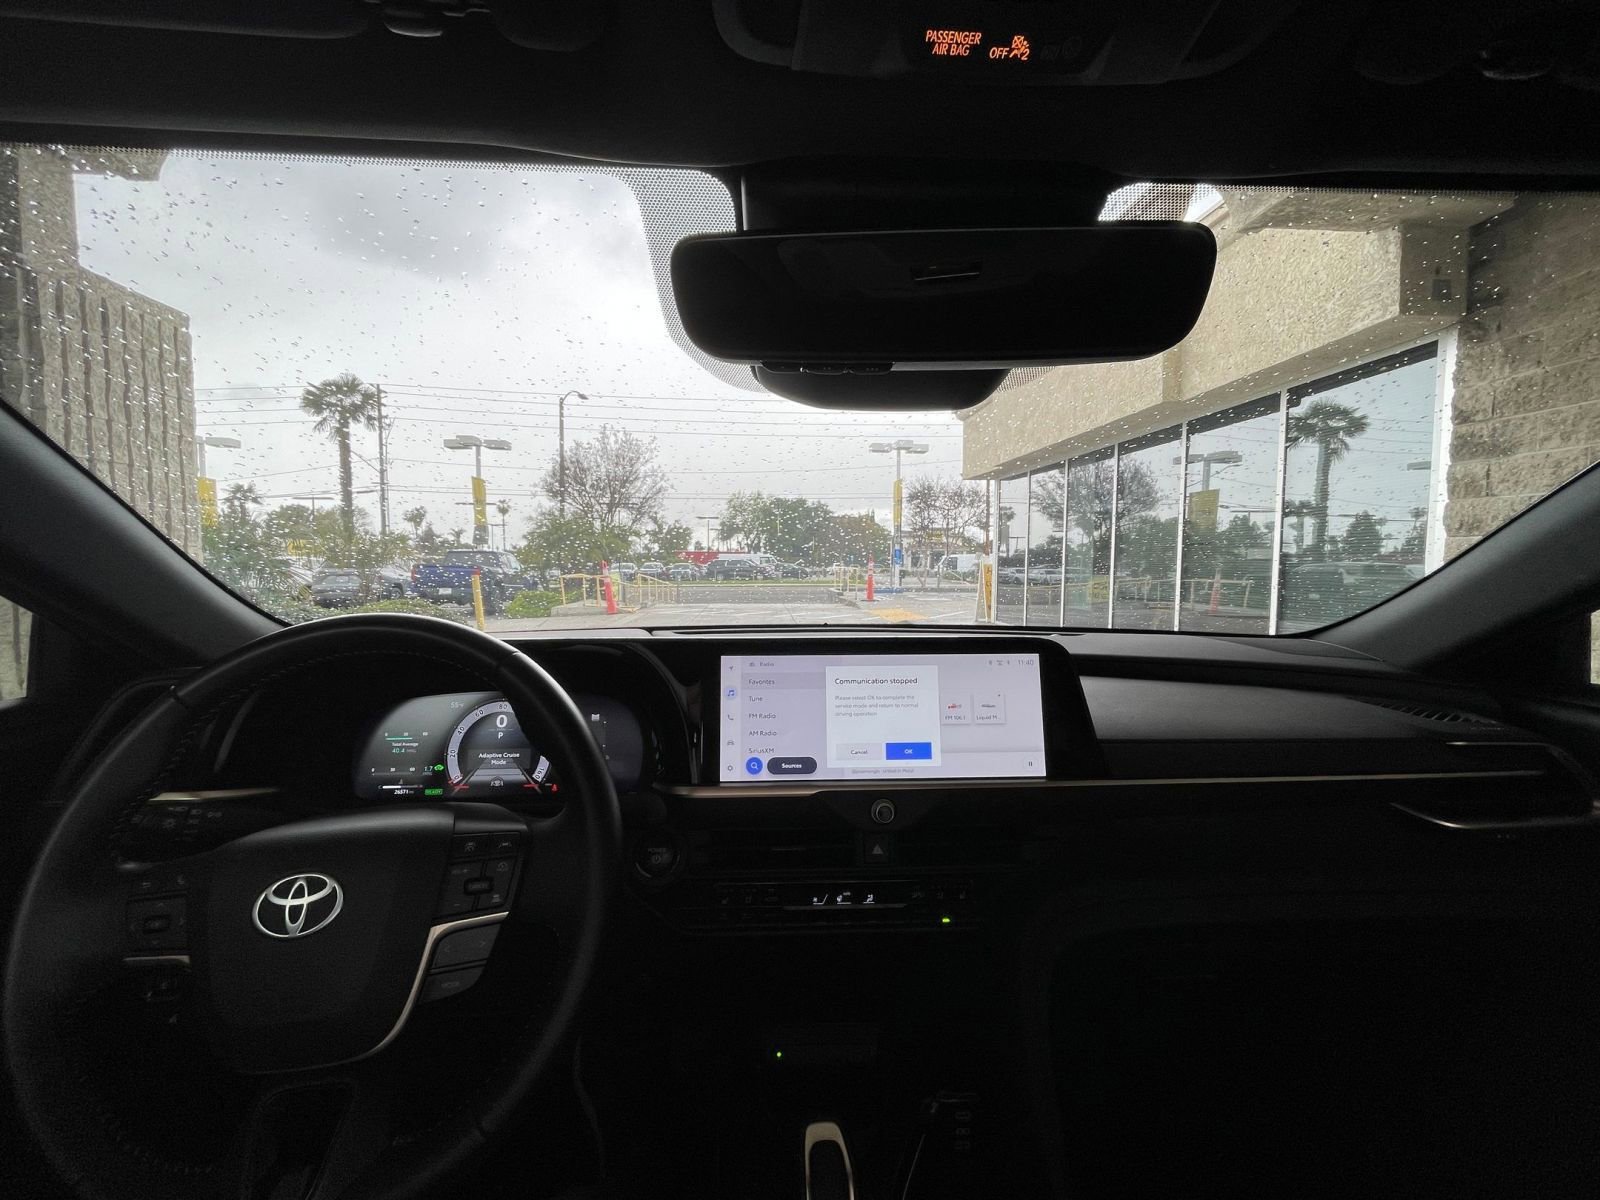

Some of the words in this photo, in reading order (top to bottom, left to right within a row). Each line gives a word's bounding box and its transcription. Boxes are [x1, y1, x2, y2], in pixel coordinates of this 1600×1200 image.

[925, 30, 982, 45] PASSENGER
[932, 44, 949, 55] AIR
[950, 44, 970, 56] BAG
[989, 47, 1010, 59] OFF
[834, 678, 888, 686] Communication
[889, 677, 918, 686] stopped
[475, 709, 484, 717] 60
[496, 714, 508, 728] 0
[457, 726, 465, 736] 40
[450, 749, 456, 758] 20
[534, 768, 545, 780] 160
